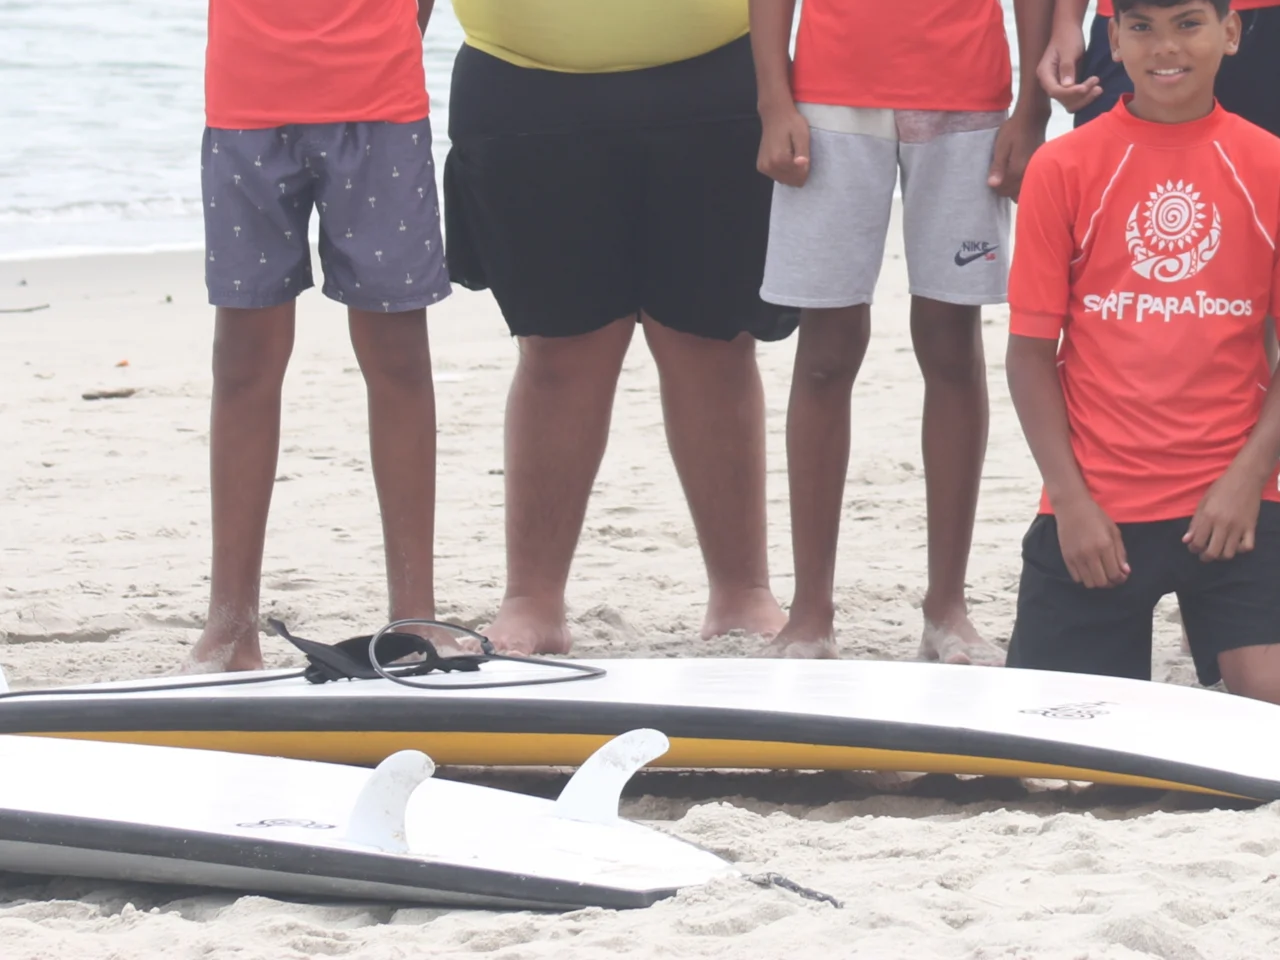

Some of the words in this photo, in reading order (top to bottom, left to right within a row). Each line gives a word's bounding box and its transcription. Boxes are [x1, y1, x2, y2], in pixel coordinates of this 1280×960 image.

[961, 241, 990, 252] NIKE
[1136, 294, 1196, 323] PARA
[1196, 290, 1252, 318] TODOS
